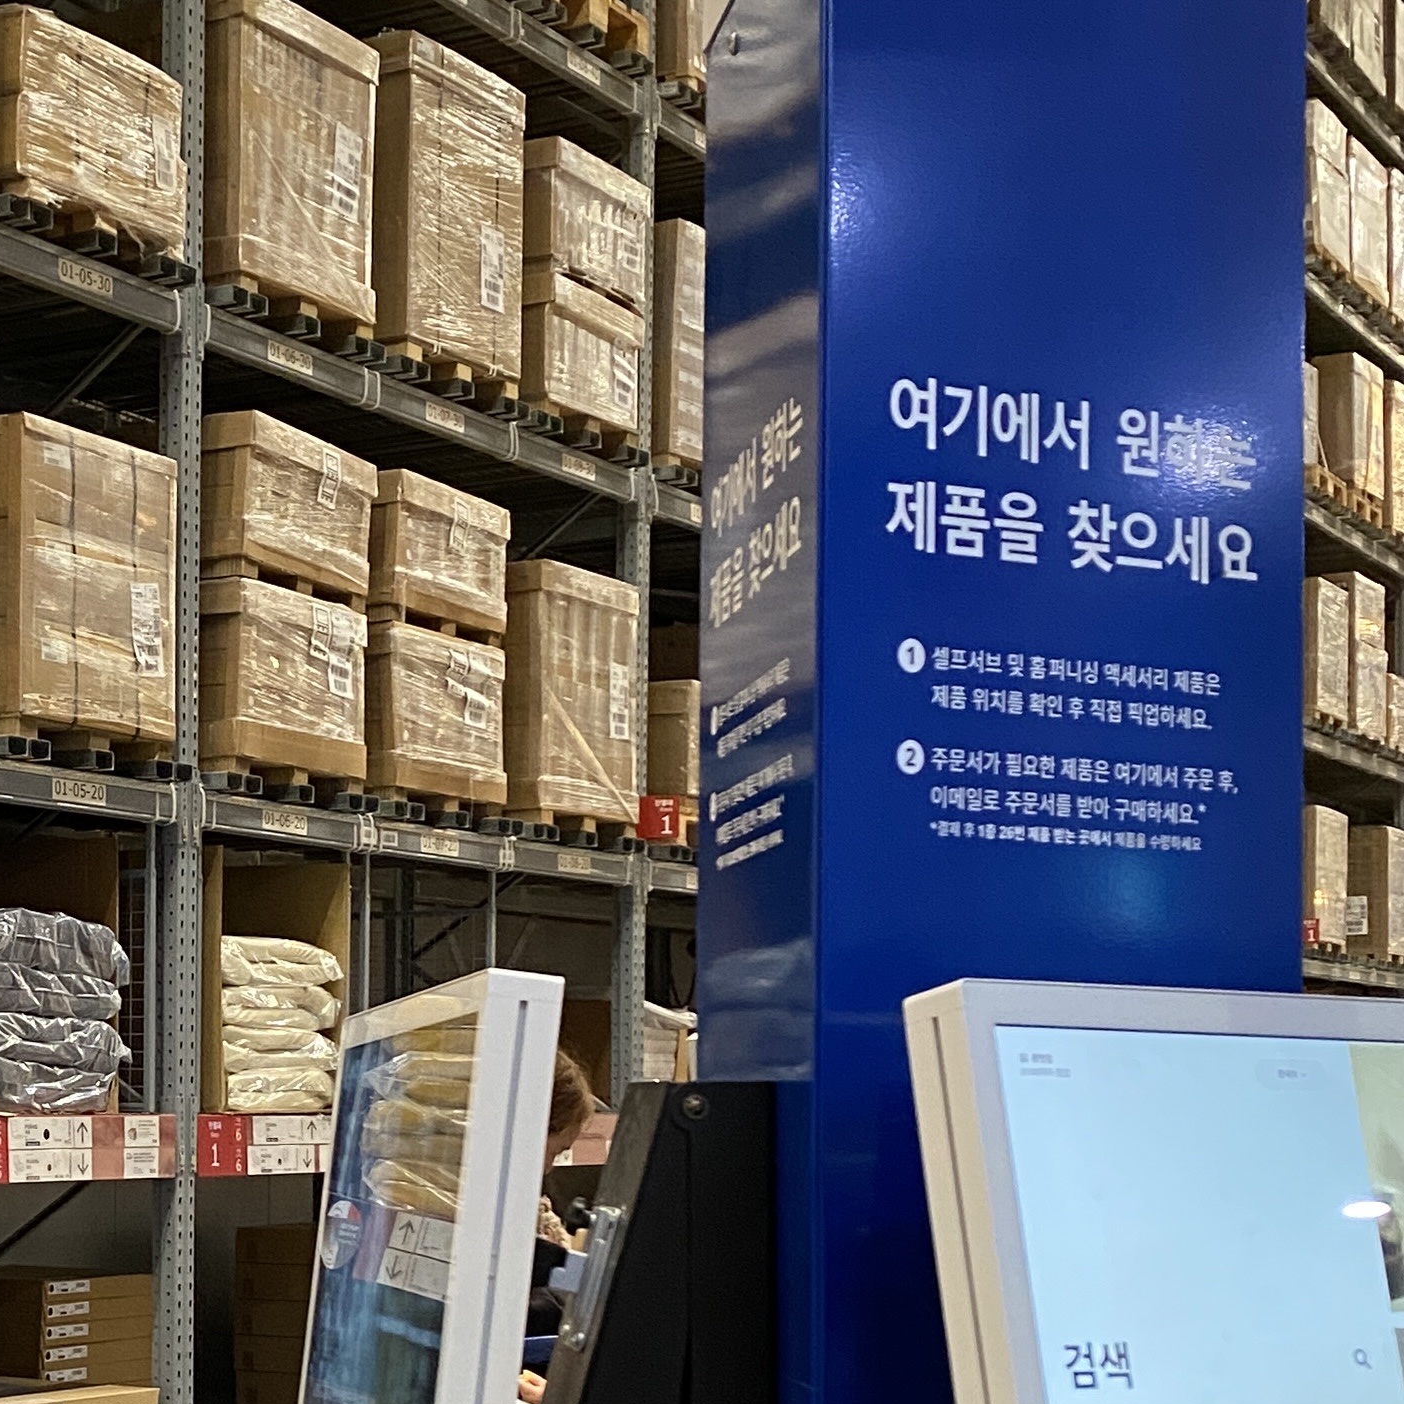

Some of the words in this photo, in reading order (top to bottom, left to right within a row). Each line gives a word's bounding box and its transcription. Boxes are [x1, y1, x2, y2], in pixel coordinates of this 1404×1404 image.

[61, 261, 111, 293] 01-05-30
[761, 397, 803, 490] 원하는
[889, 377, 1090, 470] 여기에서
[1116, 407, 1257, 490] 원하는
[885, 481, 1044, 564] 제품을
[1067, 499, 1259, 584] 찾으세요
[709, 547, 745, 628] 제품을
[748, 496, 802, 599] 찾으세요
[931, 646, 1003, 673] 셀프서브
[1007, 653, 1025, 677] 및
[1102, 662, 1169, 691] 액세서리
[1173, 670, 1222, 696] 제품은
[931, 685, 967, 710] 제품
[971, 688, 1024, 715] 위치를
[1029, 692, 1063, 718] 확인
[1068, 697, 1085, 720] 후
[1089, 698, 1123, 723] 직접
[1127, 702, 1213, 730] 픽업하세요.
[54, 780, 104, 800] 01-05-20
[931, 748, 1002, 775] 주문서가
[1005, 753, 1056, 779] 필요한
[1061, 757, 1111, 783] 제품은
[1114, 761, 1179, 788] 여기에서
[1183, 766, 1214, 791] 주문
[1218, 770, 1239, 794] 후,
[930, 785, 1001, 811] 이메일로
[1005, 790, 1072, 817] 주문서를
[1076, 795, 1110, 820] 받아
[660, 814, 673, 835] 1
[1307, 928, 1316, 942] 1
[211, 1143, 220, 1167] 1
[235, 1128, 242, 1142] 6
[235, 1159, 242, 1173] 6
[1064, 1341, 1134, 1390] 검색
